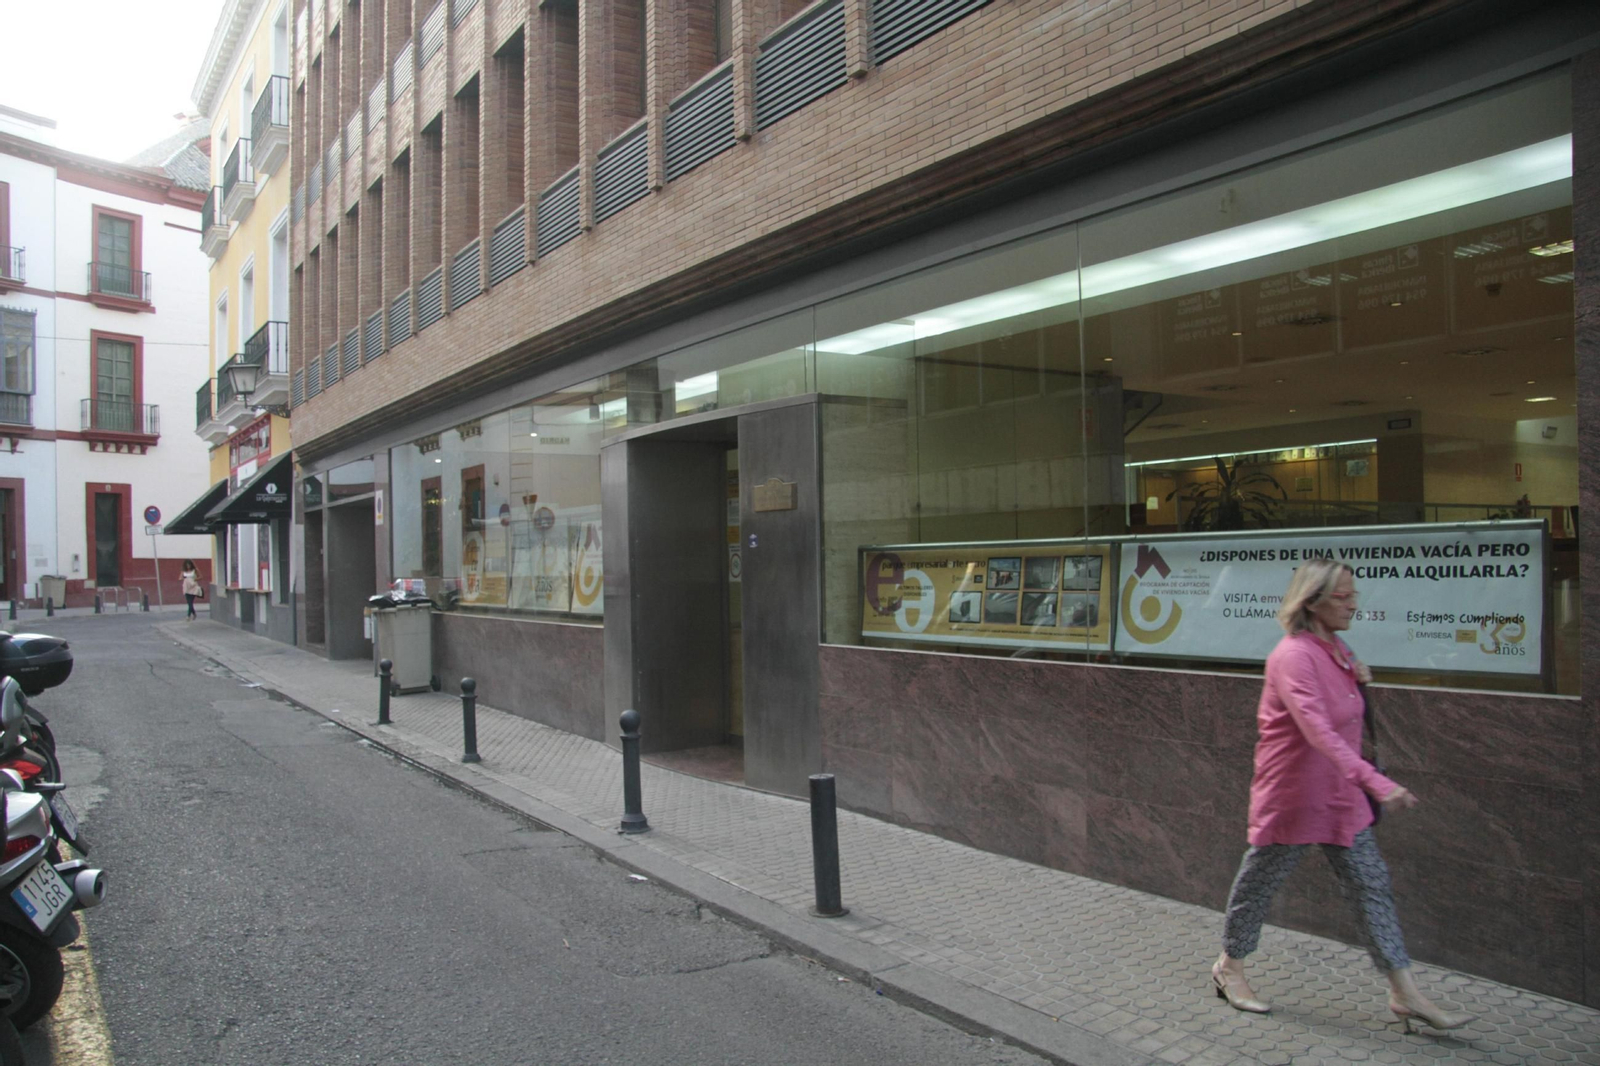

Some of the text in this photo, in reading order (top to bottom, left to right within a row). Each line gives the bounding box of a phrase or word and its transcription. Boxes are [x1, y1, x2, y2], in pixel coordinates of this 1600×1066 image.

[1199, 541, 1530, 562] ¿DISPONES DE UNA VIVIENDA VACÍA PERO
[1351, 564, 1529, 581] CUPA ALQUILARLA?
[1223, 593, 1257, 603] VISITA
[1222, 608, 1231, 618] O
[1234, 606, 1279, 618] LLÁMAN
[1406, 610, 1525, 627] Estamos cumpliendo
[1415, 631, 1453, 639] EMVISESA
[1495, 643, 1526, 656] años
[24, 863, 56, 899] 1145
[41, 884, 67, 916] JGR
